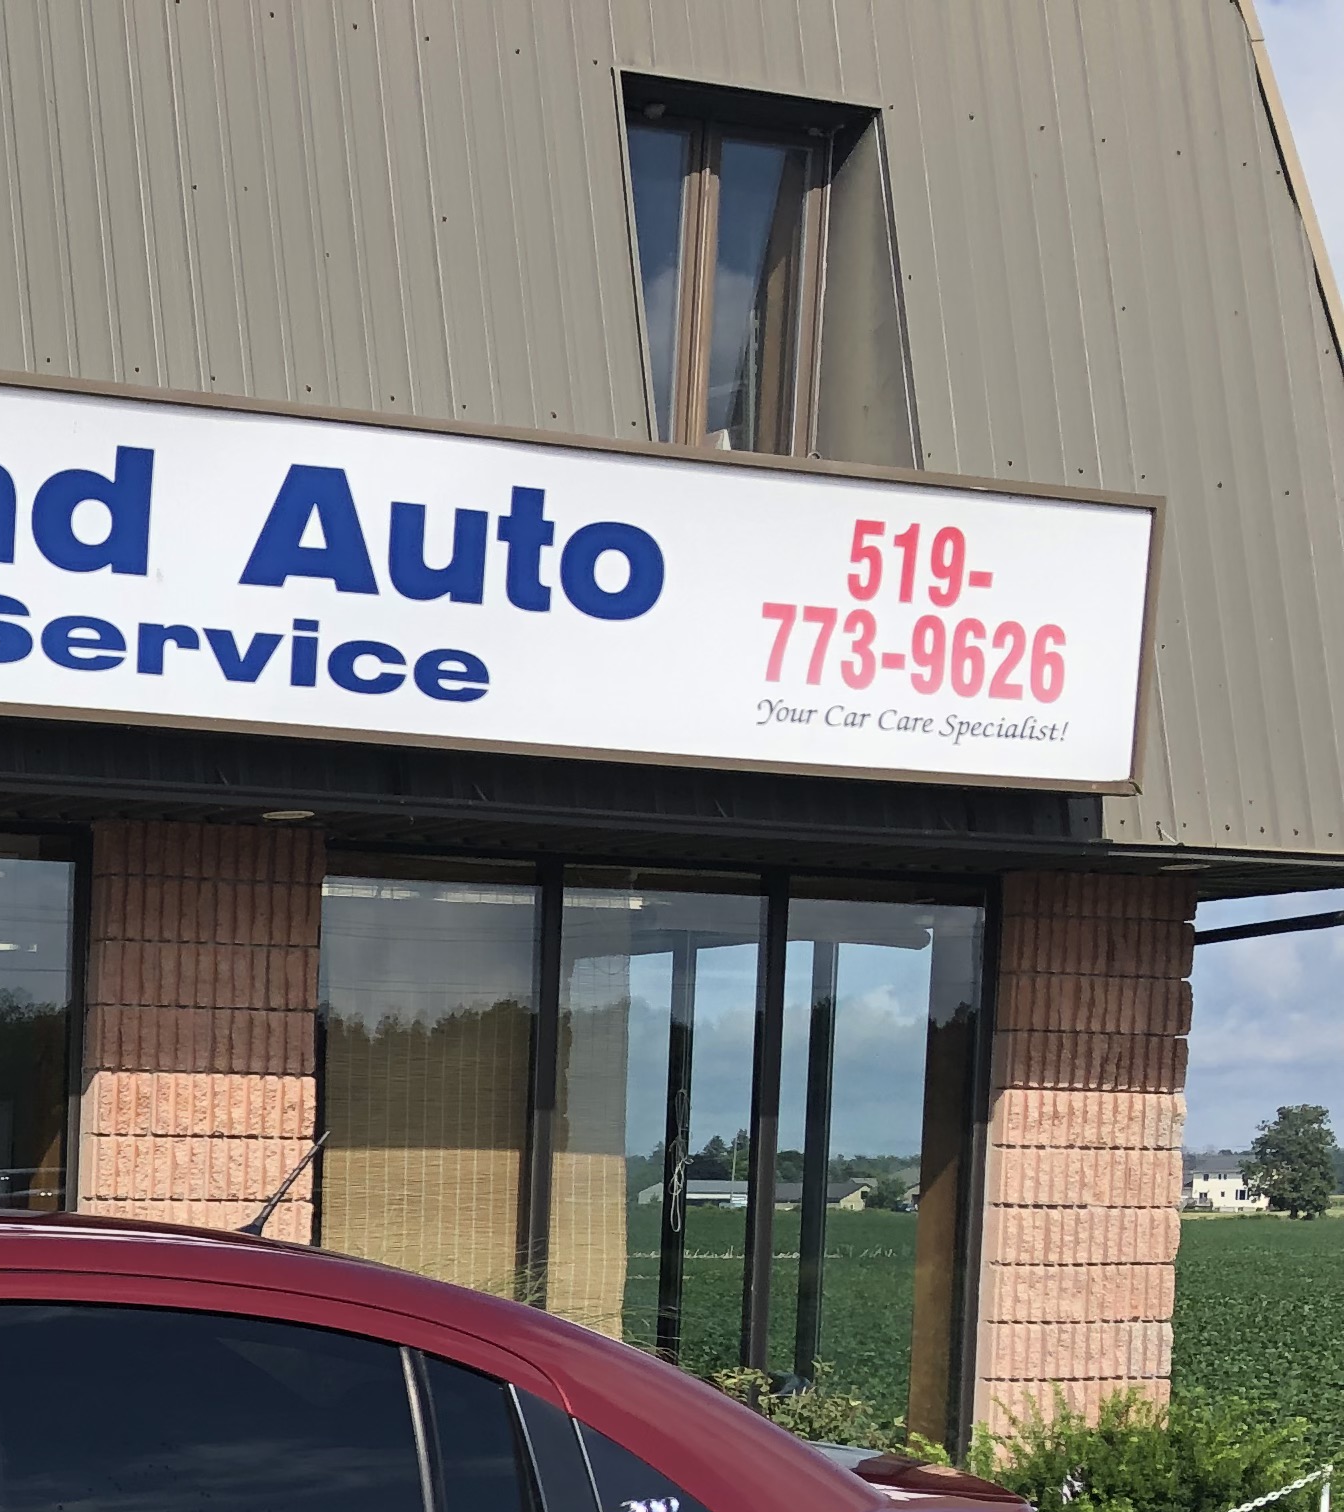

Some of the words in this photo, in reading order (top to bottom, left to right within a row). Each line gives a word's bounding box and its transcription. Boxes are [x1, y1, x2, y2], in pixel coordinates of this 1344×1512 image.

[238, 462, 665, 622] Auto
[846, 518, 994, 608] 519-
[761, 602, 1068, 704] 773-9626
[756, 698, 818, 727] Your
[824, 705, 872, 729] Car
[878, 709, 934, 734] Care
[938, 713, 1070, 745] Specialist!
